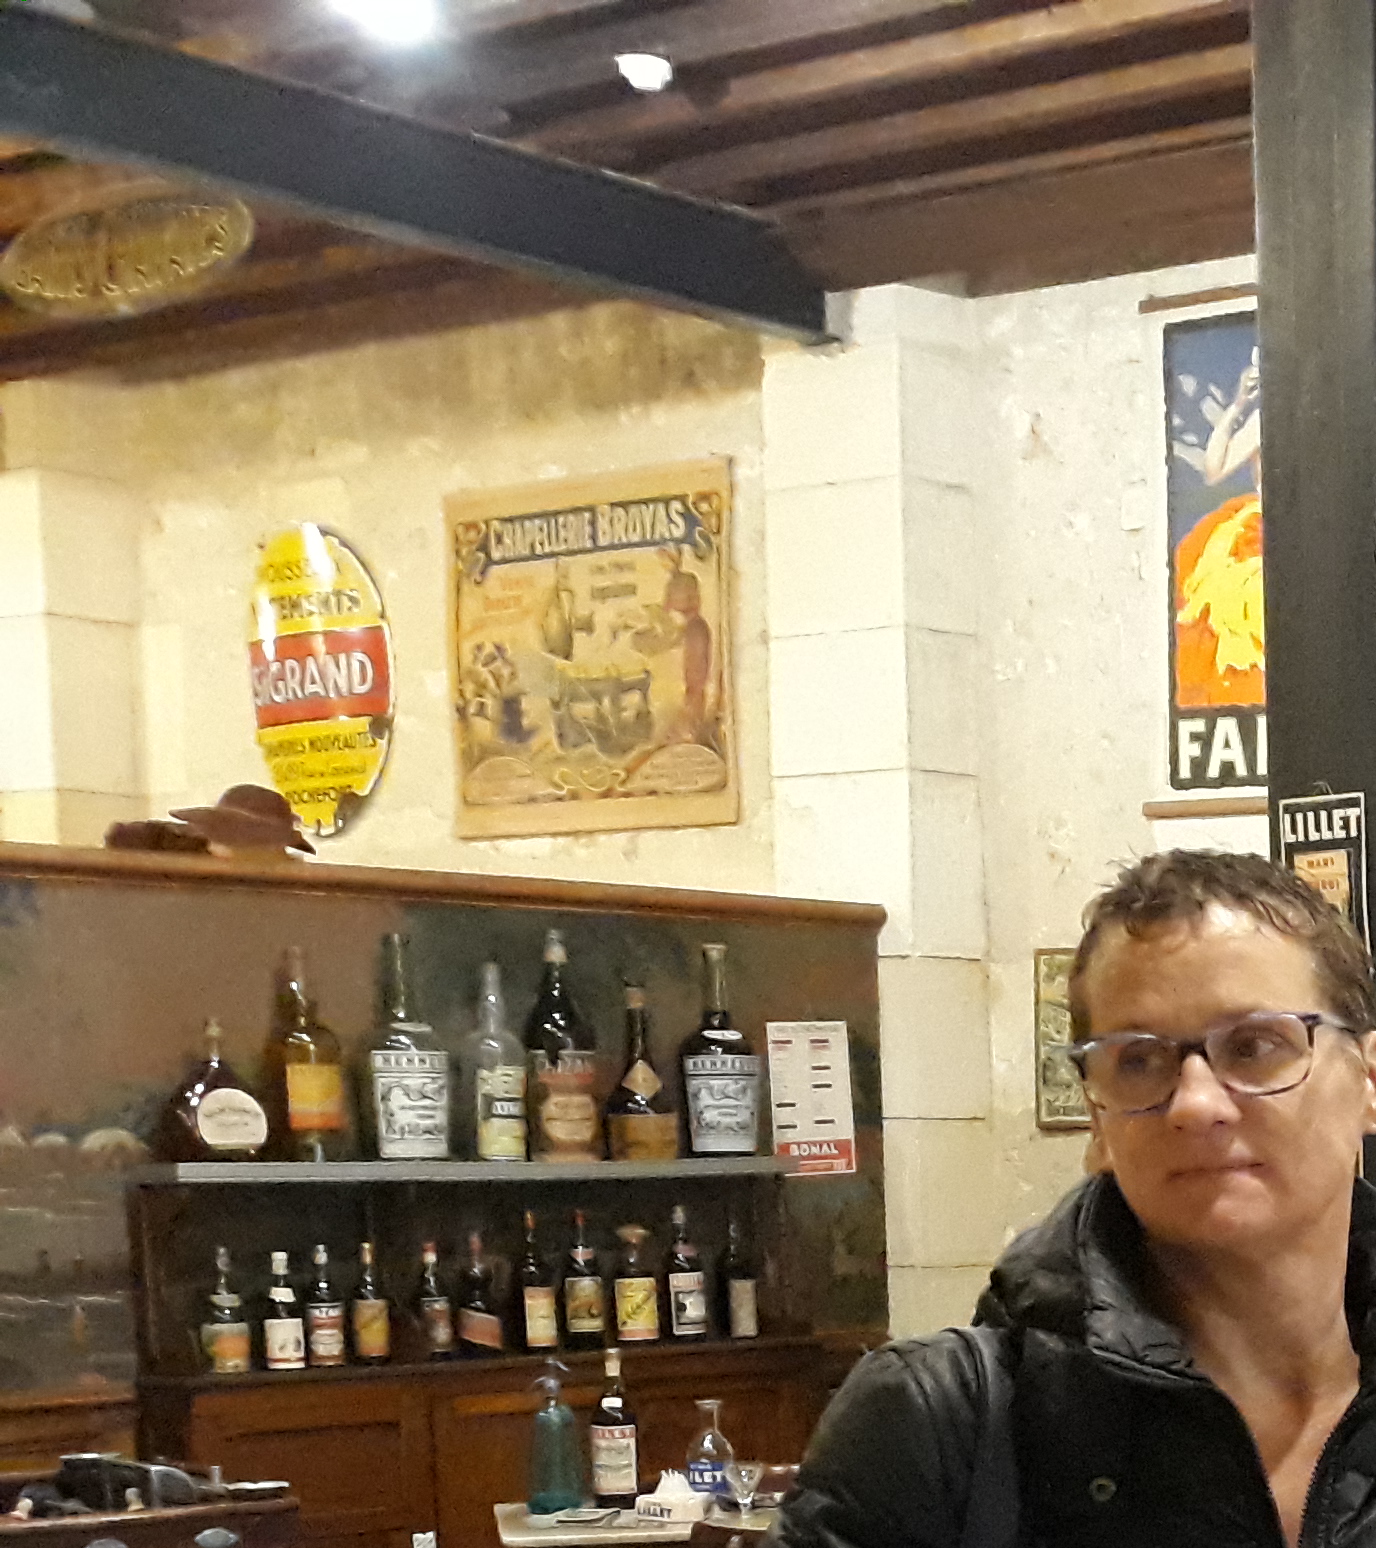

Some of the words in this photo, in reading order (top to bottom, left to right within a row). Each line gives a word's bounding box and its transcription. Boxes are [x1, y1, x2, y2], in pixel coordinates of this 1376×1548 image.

[490, 510, 594, 562] CHAPELLERIE
[1283, 807, 1361, 843] LILLET
[788, 1142, 839, 1157] BONAL
